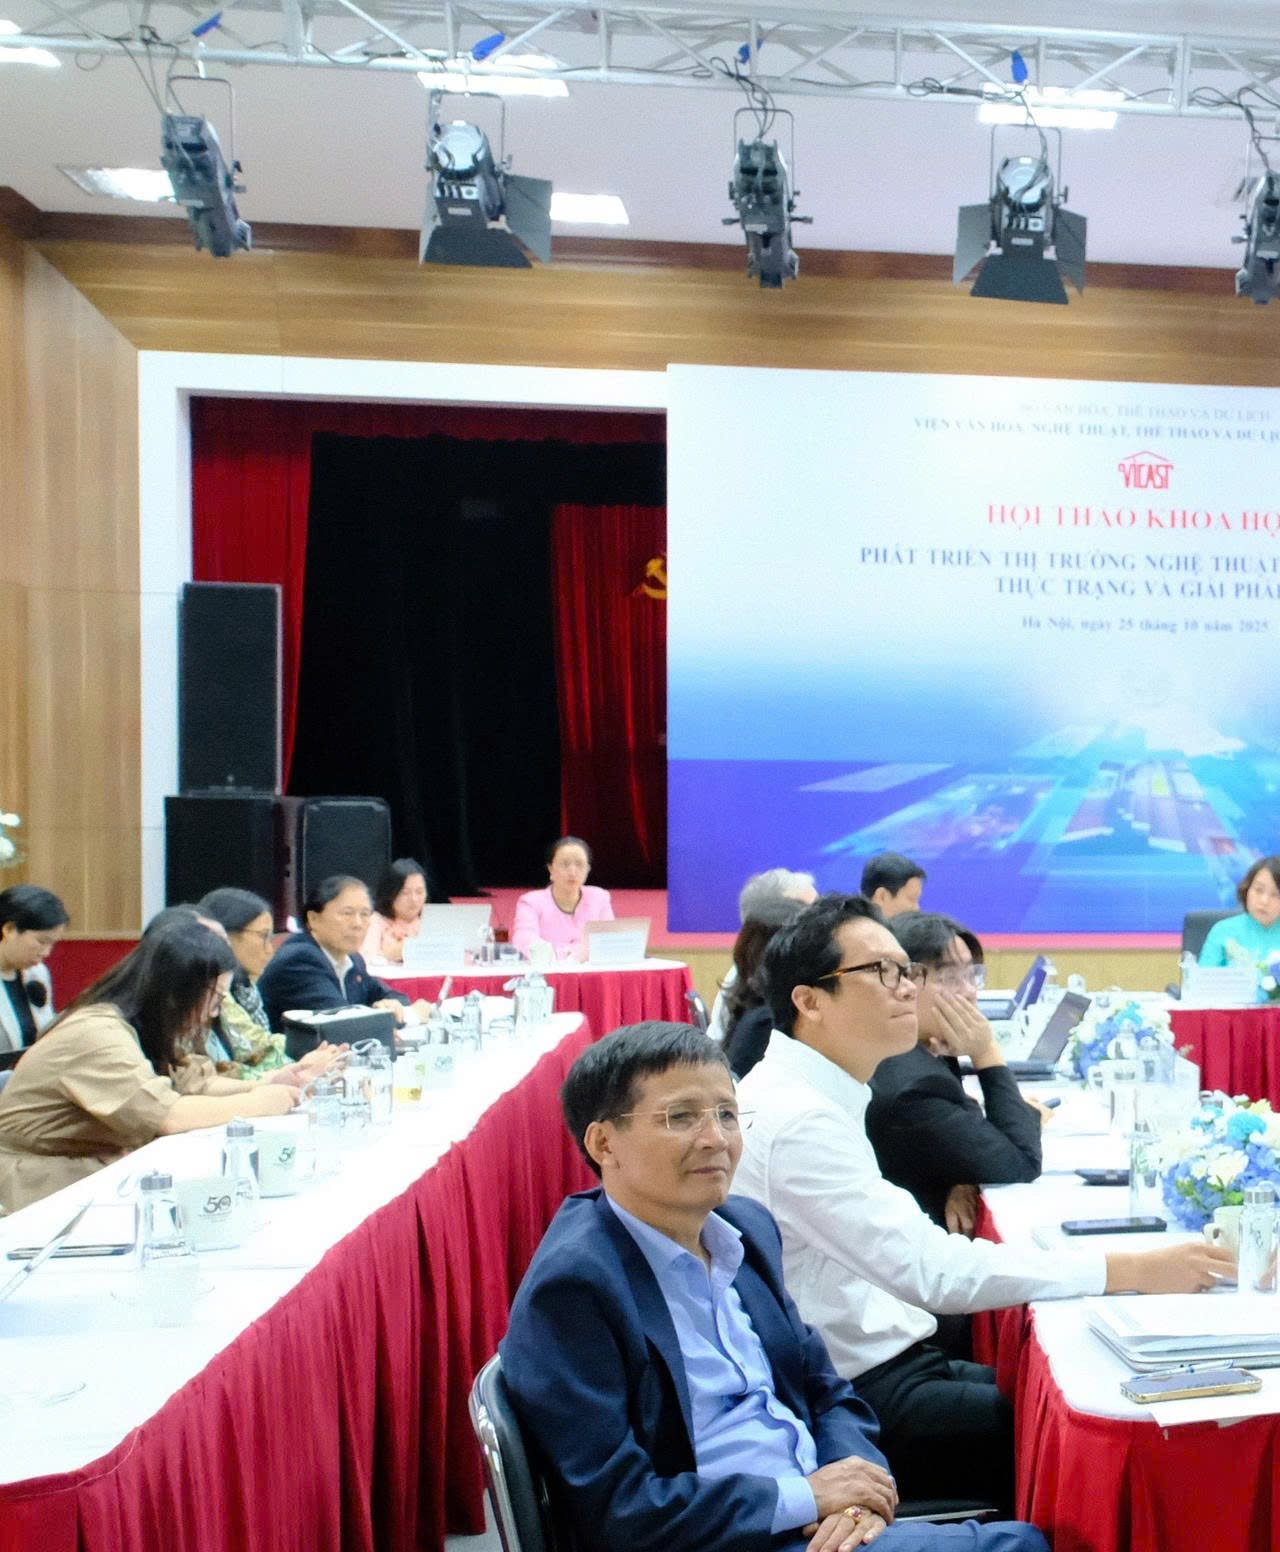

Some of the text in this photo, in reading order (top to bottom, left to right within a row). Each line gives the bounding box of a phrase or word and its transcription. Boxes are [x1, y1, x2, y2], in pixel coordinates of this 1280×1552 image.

[1237, 428, 1255, 441] DU
[1118, 462, 1174, 490] VICAST
[1147, 508, 1233, 531] KHOA
[860, 543, 917, 564] PHÁT
[1002, 551, 1038, 573] THỊ
[994, 575, 1053, 599] THỰC
[1064, 577, 1136, 601] TRẠNG
[1144, 577, 1172, 598] VÀ
[1118, 617, 1134, 631] 25
[1138, 618, 1179, 635] tháng
[1183, 619, 1199, 632] 10
[1239, 620, 1269, 633] 2025
